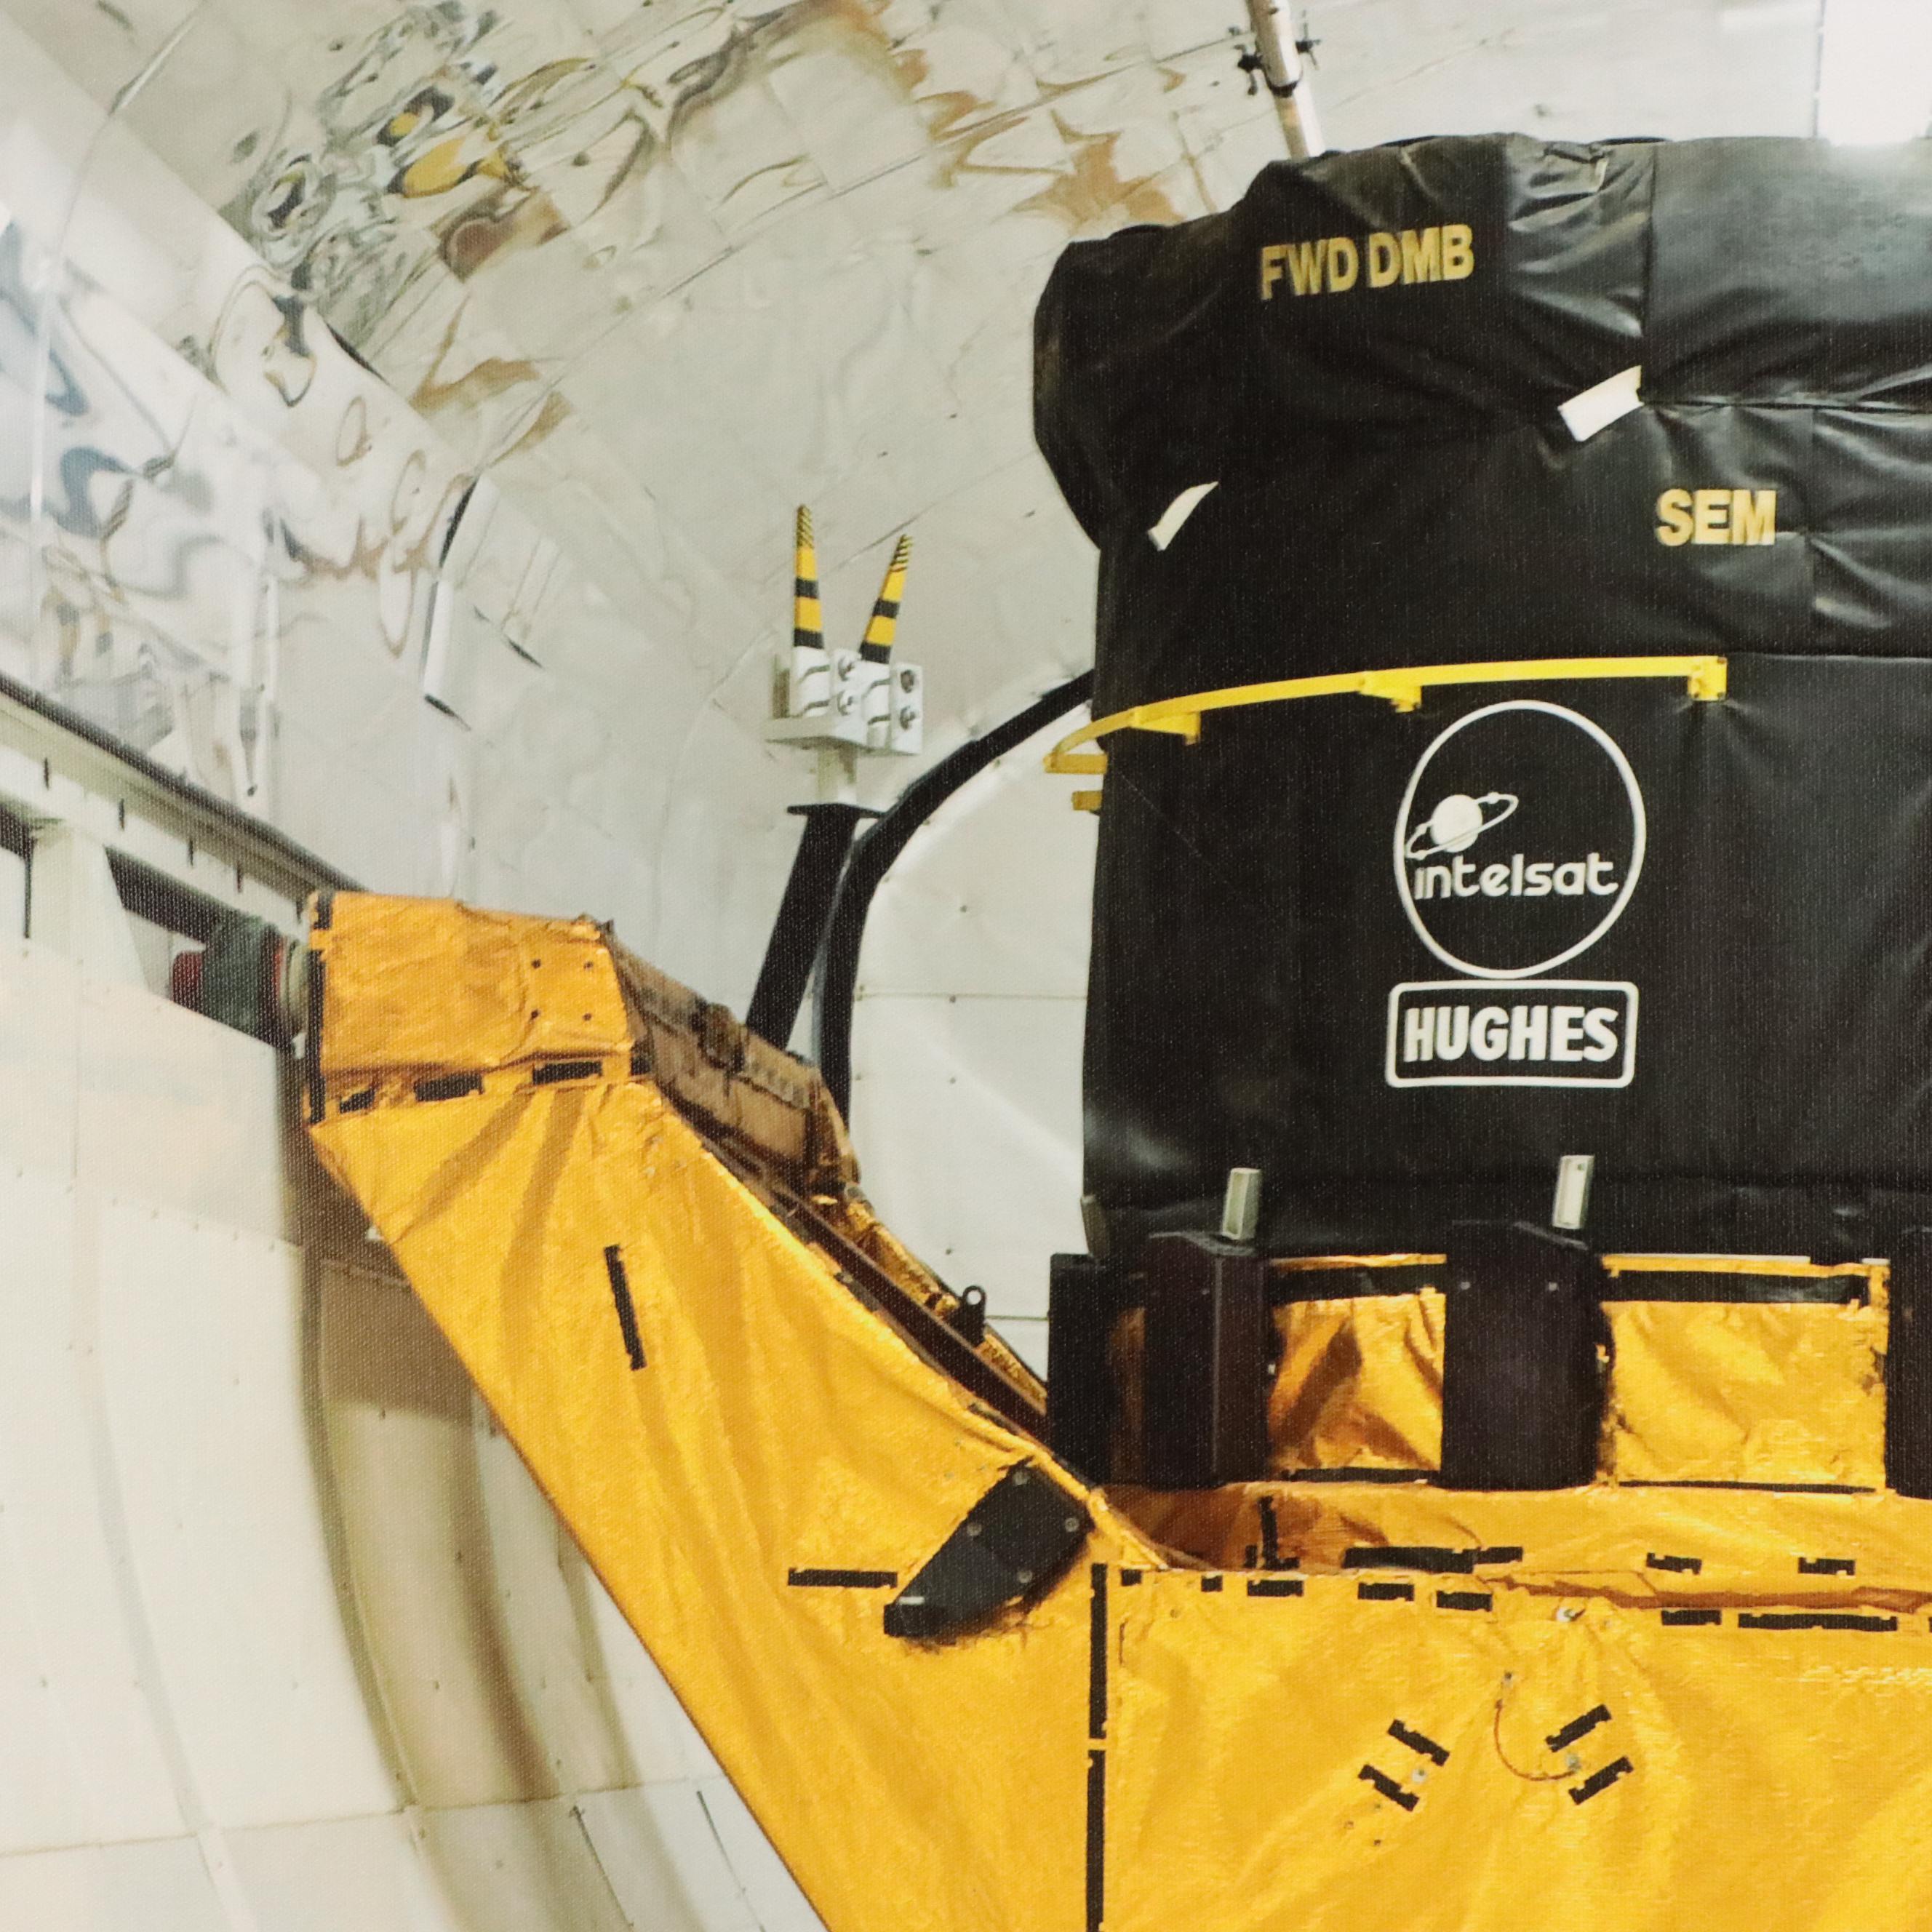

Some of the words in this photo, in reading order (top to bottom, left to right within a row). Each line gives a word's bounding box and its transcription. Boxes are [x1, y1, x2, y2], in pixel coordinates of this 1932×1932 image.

[1260, 237, 1360, 300] FWD
[1368, 223, 1475, 290] DMB
[1655, 488, 1777, 546] SEM
[1413, 852, 1619, 900] intelsat
[1403, 1005, 1619, 1063] HUGHES
